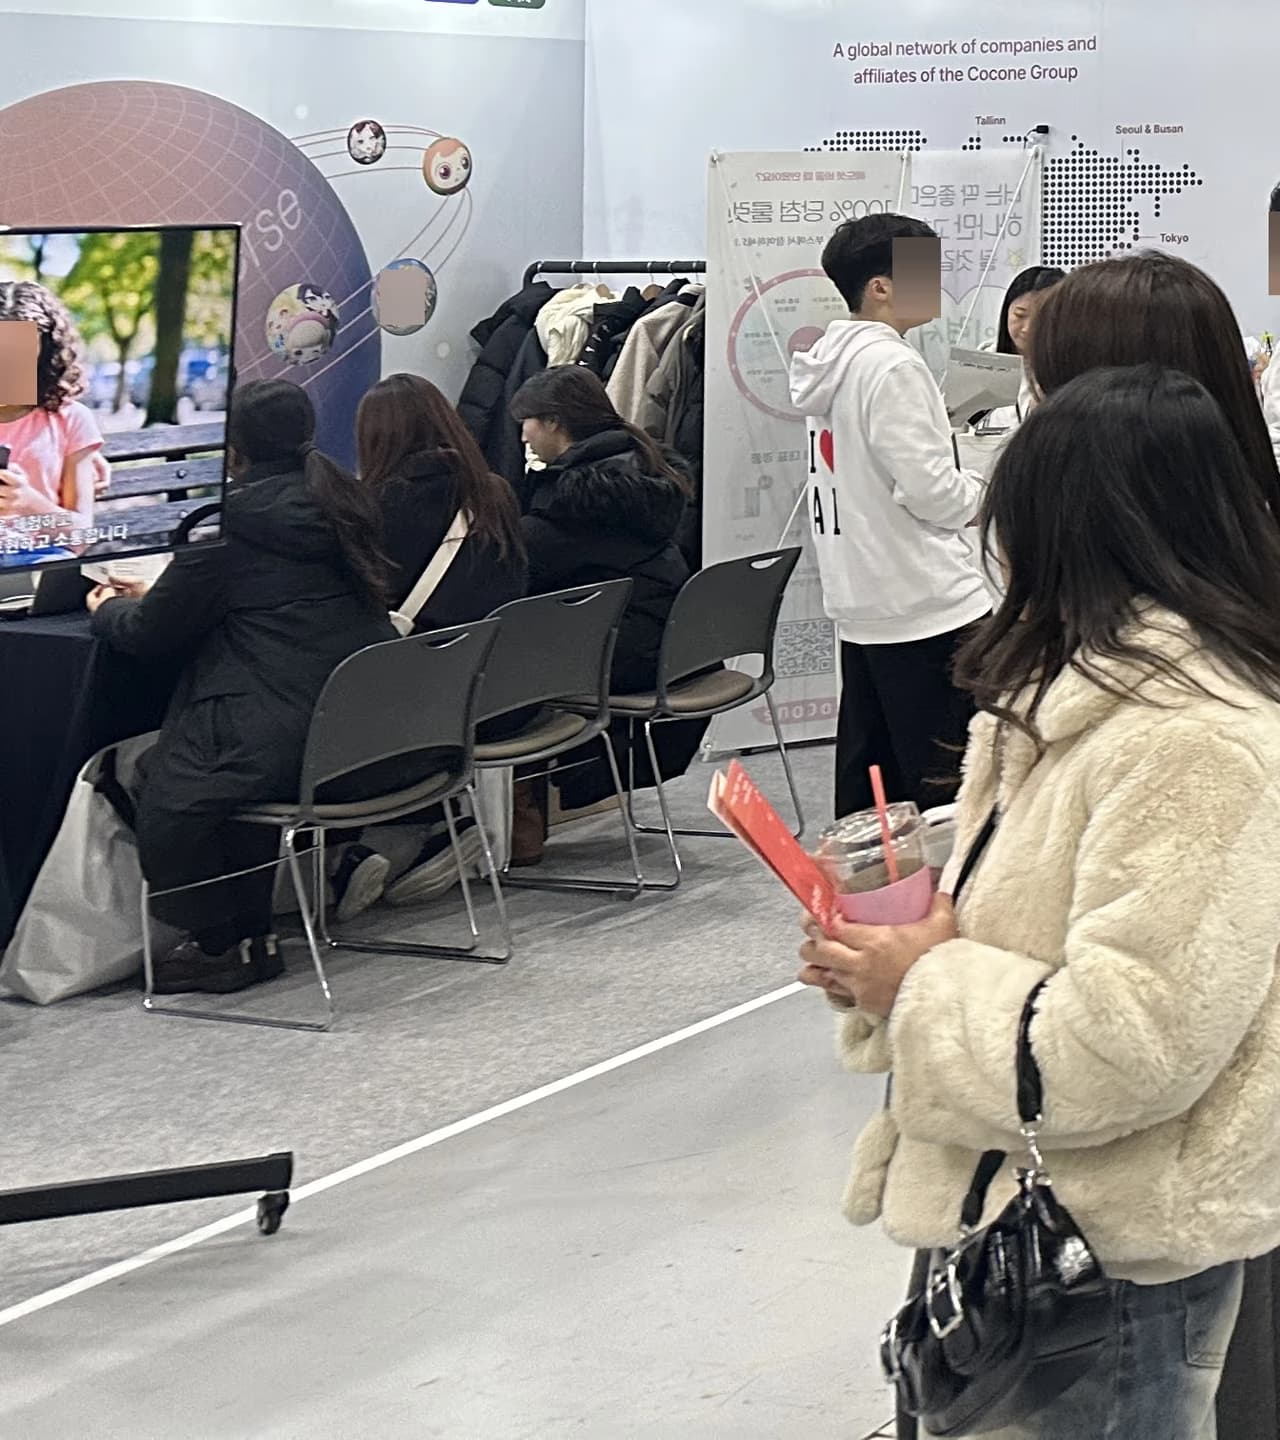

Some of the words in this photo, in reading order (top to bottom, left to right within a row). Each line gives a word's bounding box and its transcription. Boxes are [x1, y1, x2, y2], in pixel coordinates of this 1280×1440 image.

[832, 43, 844, 58] A
[847, 41, 893, 61] global
[895, 40, 958, 56] network
[961, 39, 977, 55] of
[980, 38, 1064, 56] companies
[1067, 35, 1097, 51] and
[853, 67, 917, 84] affiliates
[920, 66, 936, 82] of
[939, 66, 964, 82] the
[967, 64, 1027, 82] Cocone
[1030, 64, 1078, 82] Group
[975, 115, 1007, 127] Tallinn
[1115, 124, 1142, 135] Seoul
[1144, 124, 1151, 134] &
[1153, 124, 1184, 134] Busan
[240, 189, 302, 279] rse
[1160, 233, 1189, 244] Tokyo
